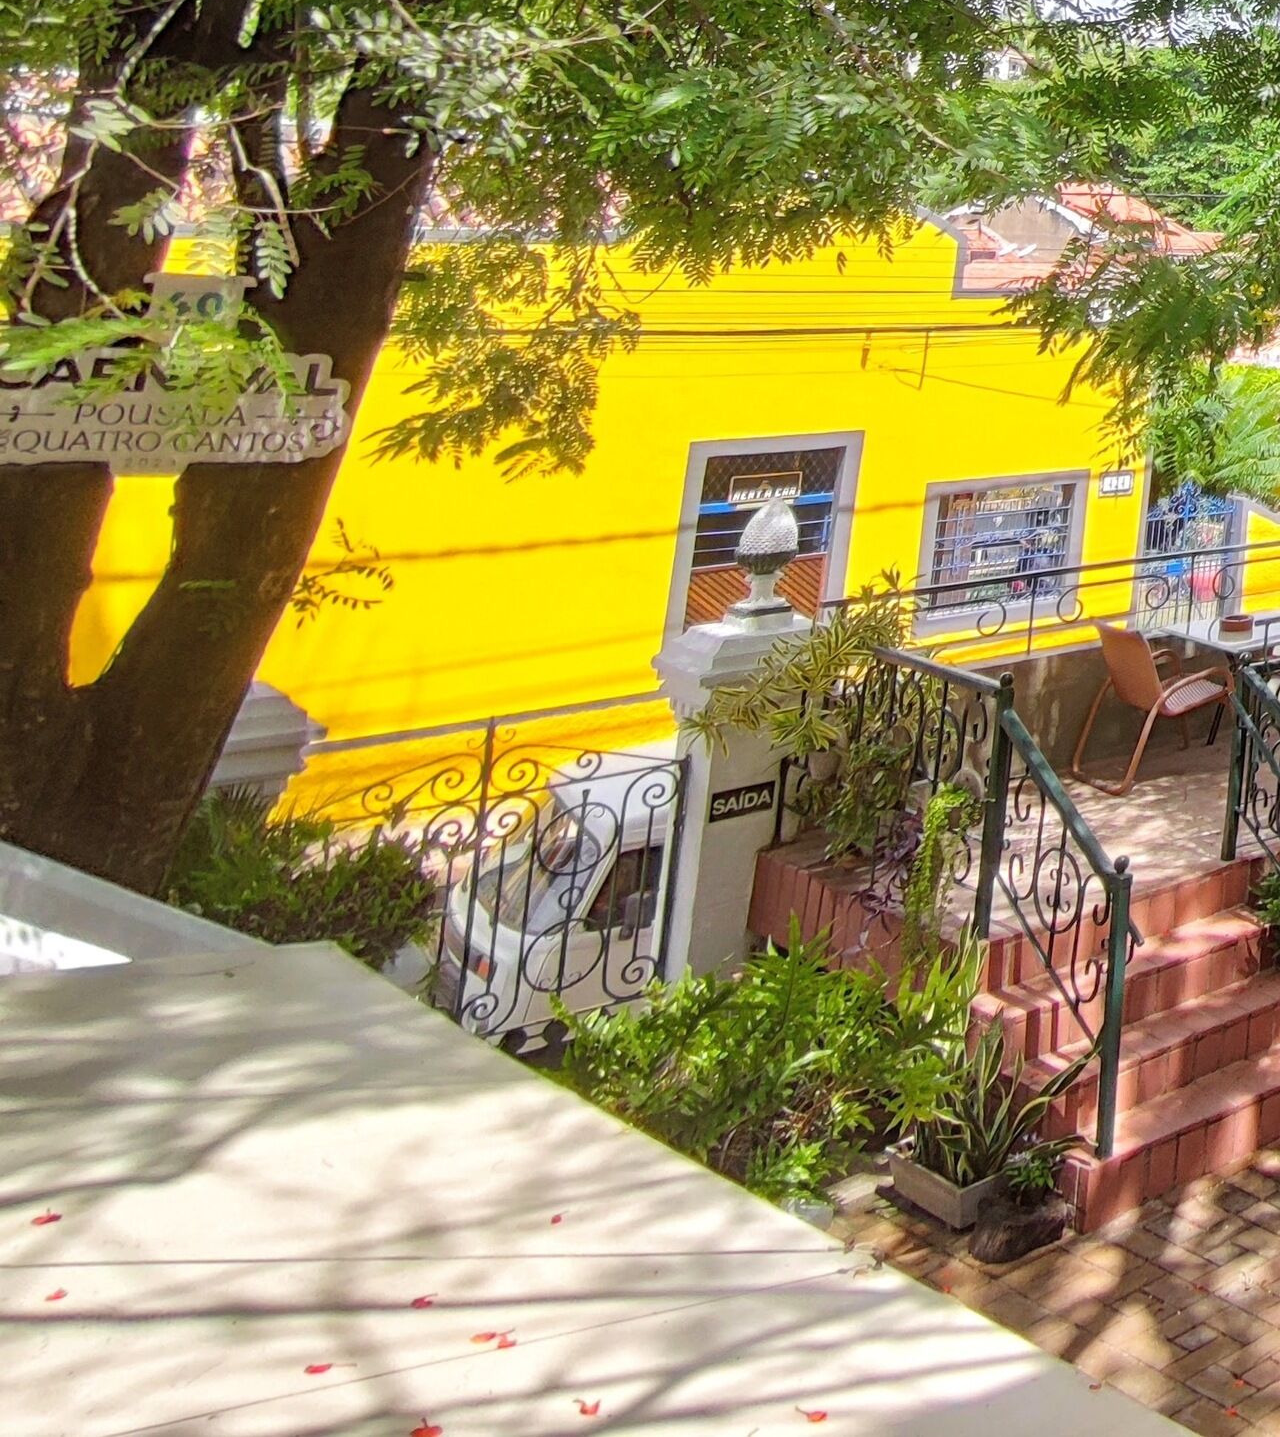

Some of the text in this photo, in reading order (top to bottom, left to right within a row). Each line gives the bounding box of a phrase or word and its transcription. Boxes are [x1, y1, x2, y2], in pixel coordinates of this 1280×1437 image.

[73, 403, 246, 426] POUSADA
[13, 429, 161, 453] QUATRO
[171, 432, 304, 452] CANTOS
[712, 789, 771, 815] SAÍDA
